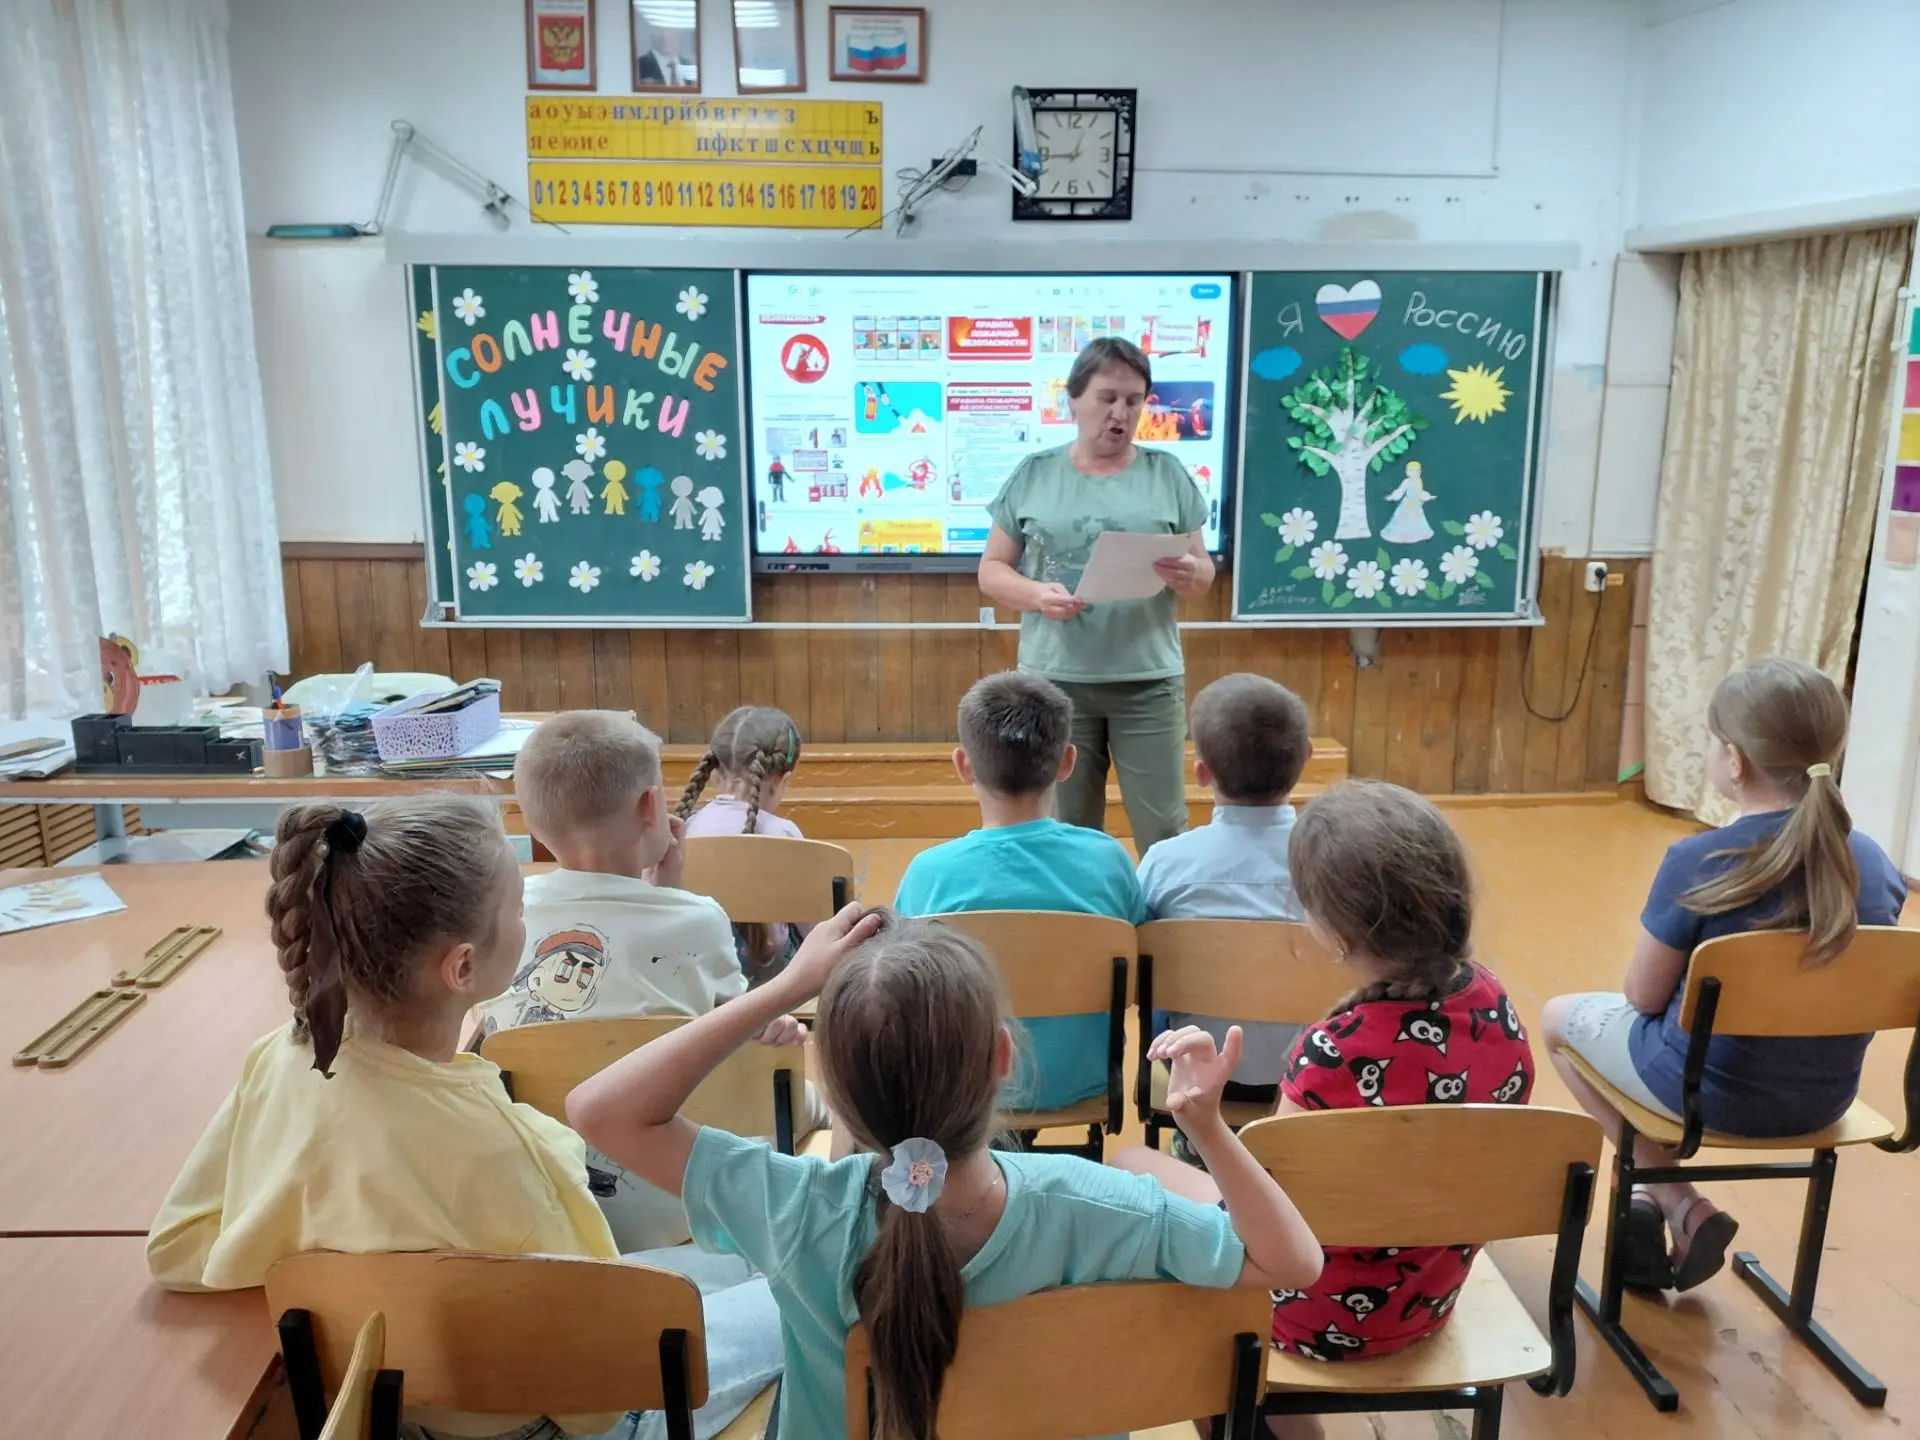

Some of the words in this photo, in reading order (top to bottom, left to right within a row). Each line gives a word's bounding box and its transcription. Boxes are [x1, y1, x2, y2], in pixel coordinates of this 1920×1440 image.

[1068, 112, 1082, 130] 12
[1100, 146, 1111, 163] 3
[534, 180, 542, 205] 0
[548, 180, 554, 205] 1
[558, 180, 566, 205] 2
[572, 180, 580, 206] 3
[584, 180, 592, 205] 4
[596, 180, 604, 206] 5
[608, 181, 616, 206] 6
[620, 181, 628, 206] 7
[633, 182, 640, 206] 8
[645, 181, 652, 206] 9
[658, 181, 673, 206] 10
[678, 182, 692, 207] 11
[698, 182, 714, 207] 12
[719, 182, 734, 208] 13
[739, 182, 754, 207] 14
[760, 184, 775, 208] 15
[780, 184, 795, 209] 16
[800, 184, 816, 210] 17
[820, 185, 836, 210] 18
[841, 185, 856, 210] 19
[861, 186, 876, 210] 20
[1068, 180, 1078, 196] 6
[1277, 302, 1304, 339] Я
[446, 304, 728, 391] СОЛНЕЧНЫЕ
[480, 384, 690, 440] ЛУЧИКИ
